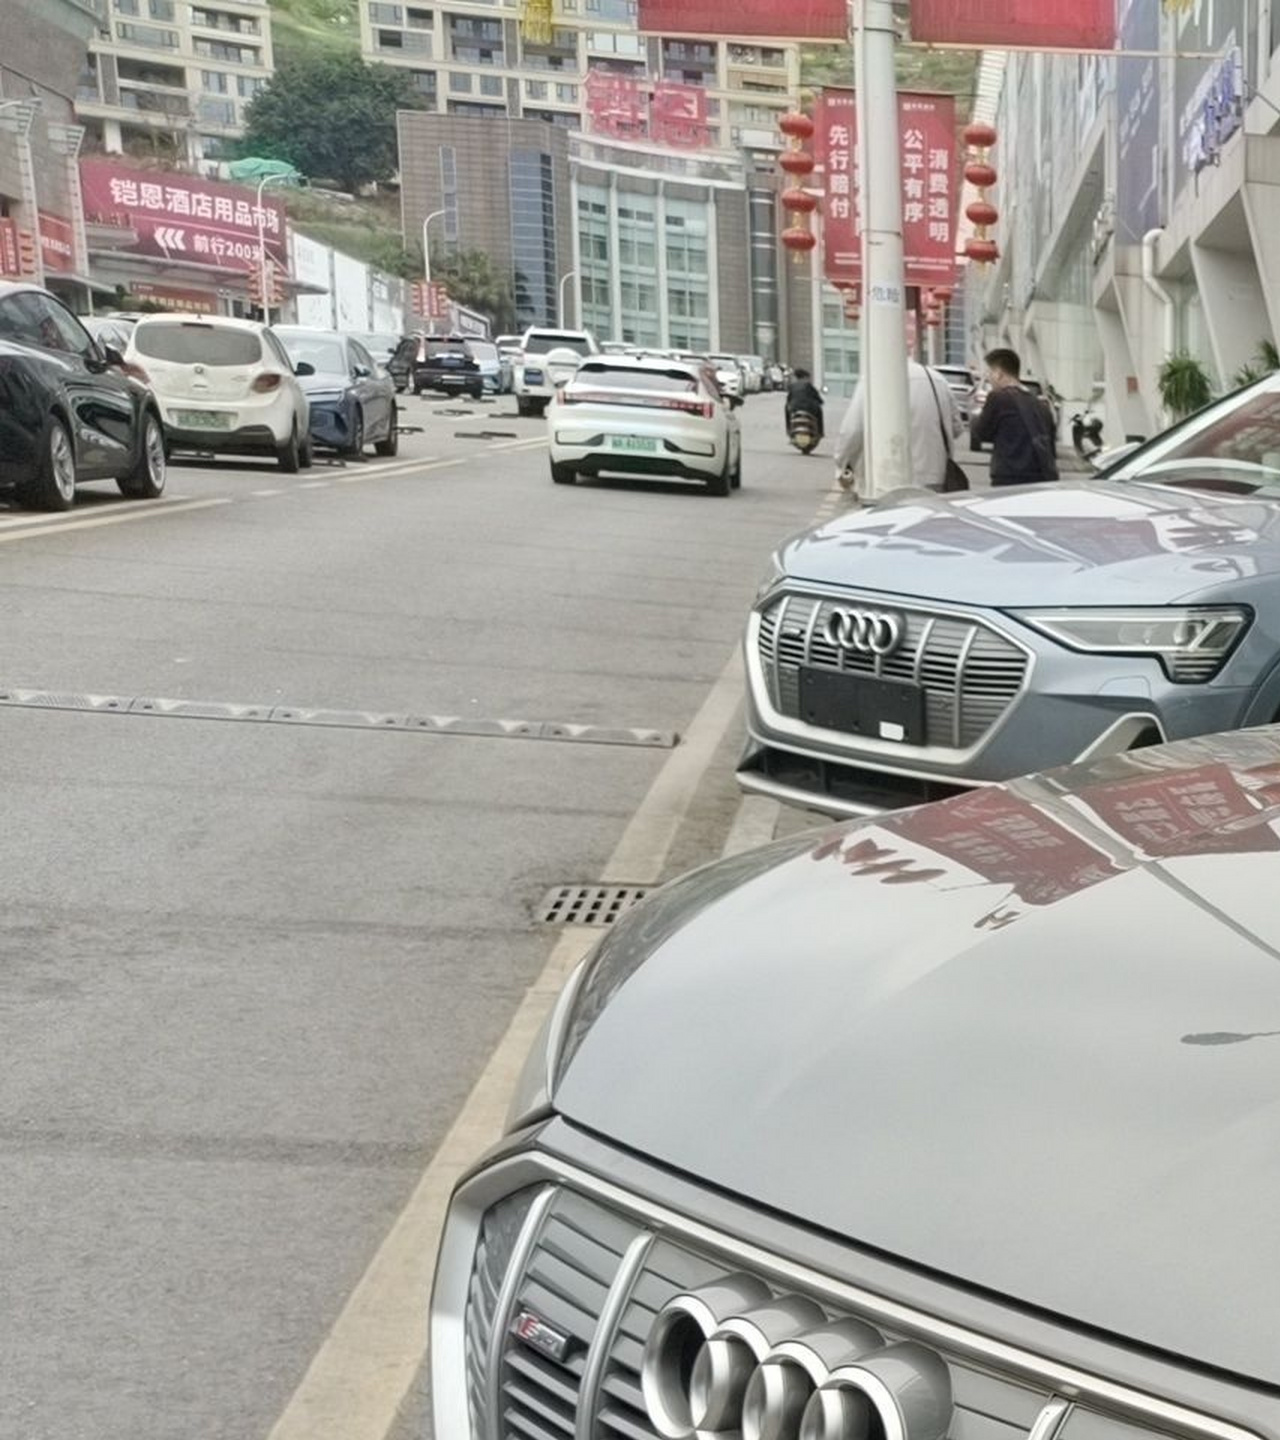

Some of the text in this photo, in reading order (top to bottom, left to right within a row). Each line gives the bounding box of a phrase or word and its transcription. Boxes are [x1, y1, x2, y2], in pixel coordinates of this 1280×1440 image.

[108, 178, 280, 234] 铠恩酒店用品市场
[829, 125, 850, 219] 先行赔付
[903, 129, 924, 223] 公平有序
[928, 148, 950, 243] 消费透明
